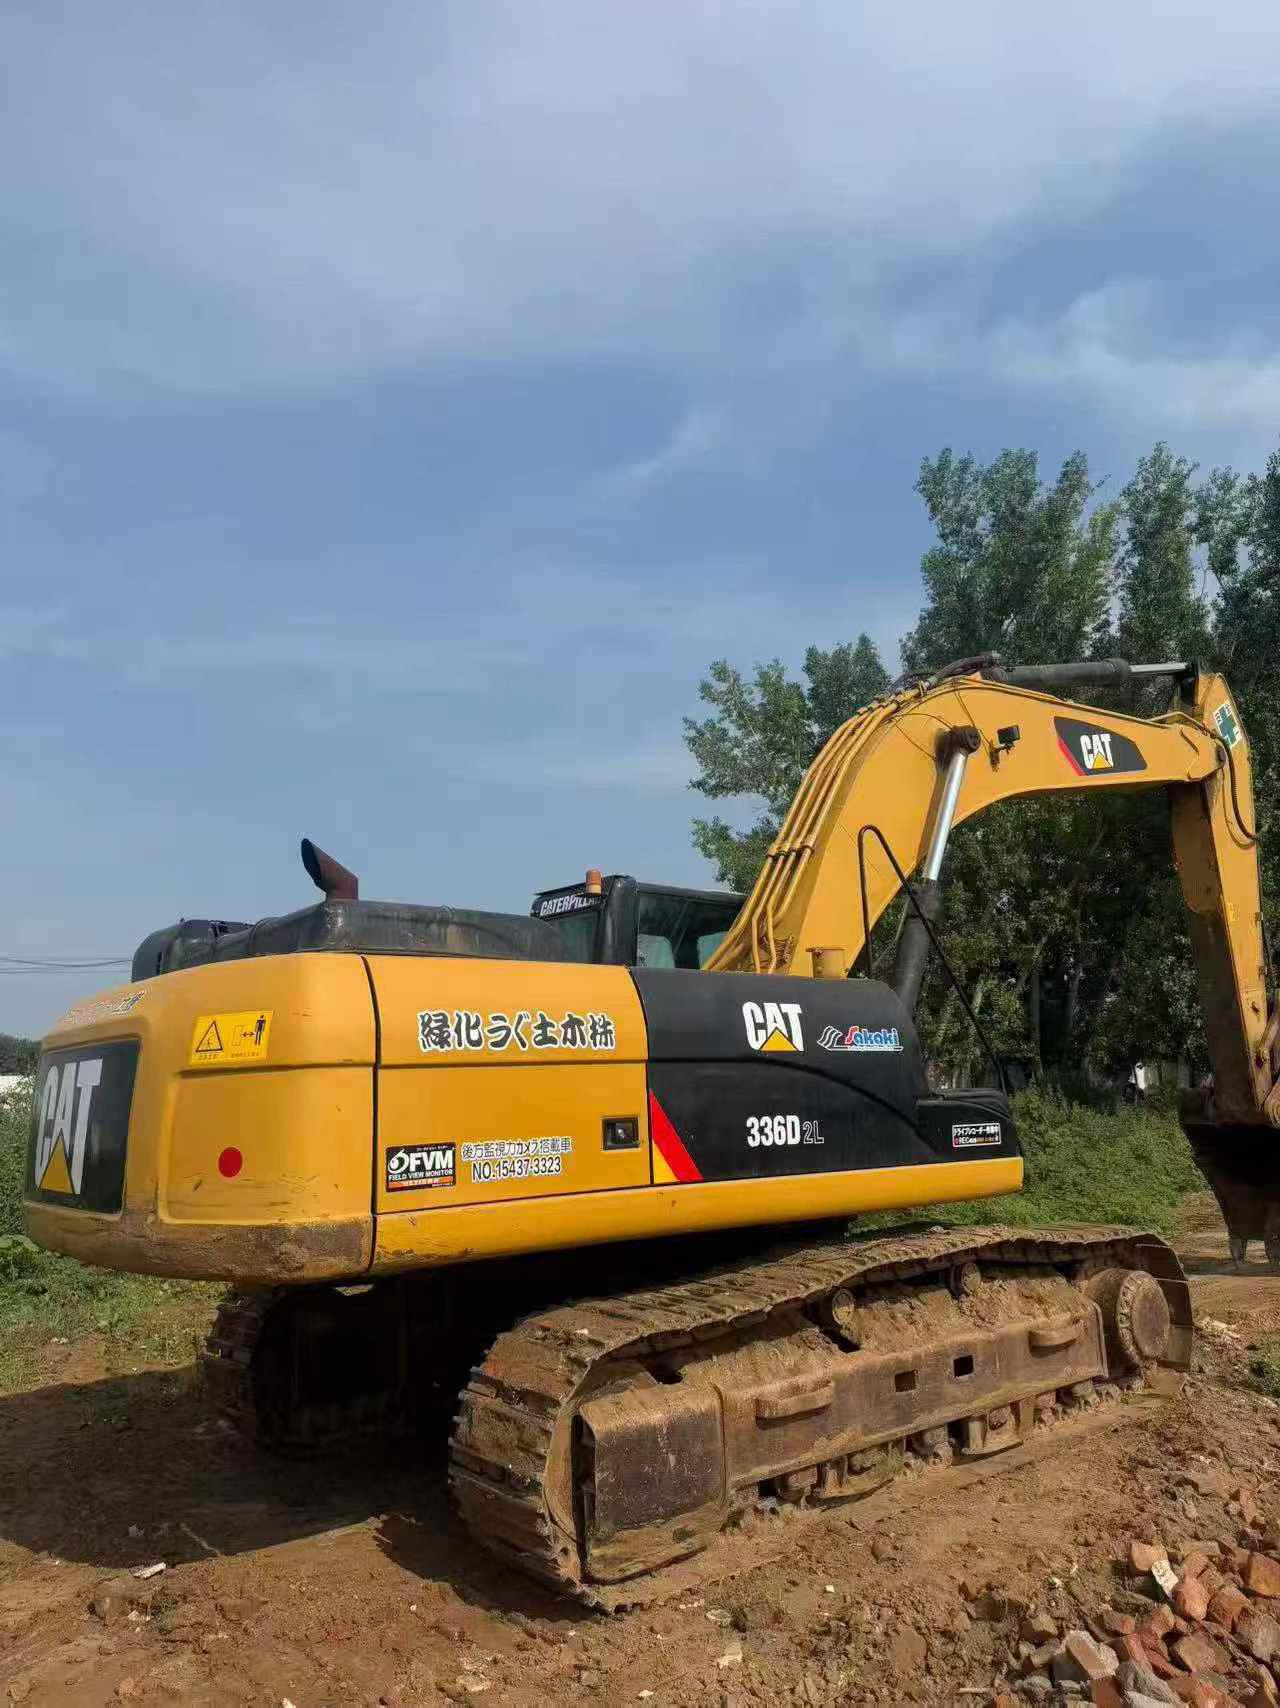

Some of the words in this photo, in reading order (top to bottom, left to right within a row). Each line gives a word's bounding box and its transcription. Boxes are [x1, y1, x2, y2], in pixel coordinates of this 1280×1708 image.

[1080, 733, 1114, 769] CAT
[742, 1001, 804, 1052] CAT
[845, 1025, 900, 1046] Sakaki
[34, 1057, 103, 1196] CAT
[746, 1115, 801, 1147] 336D
